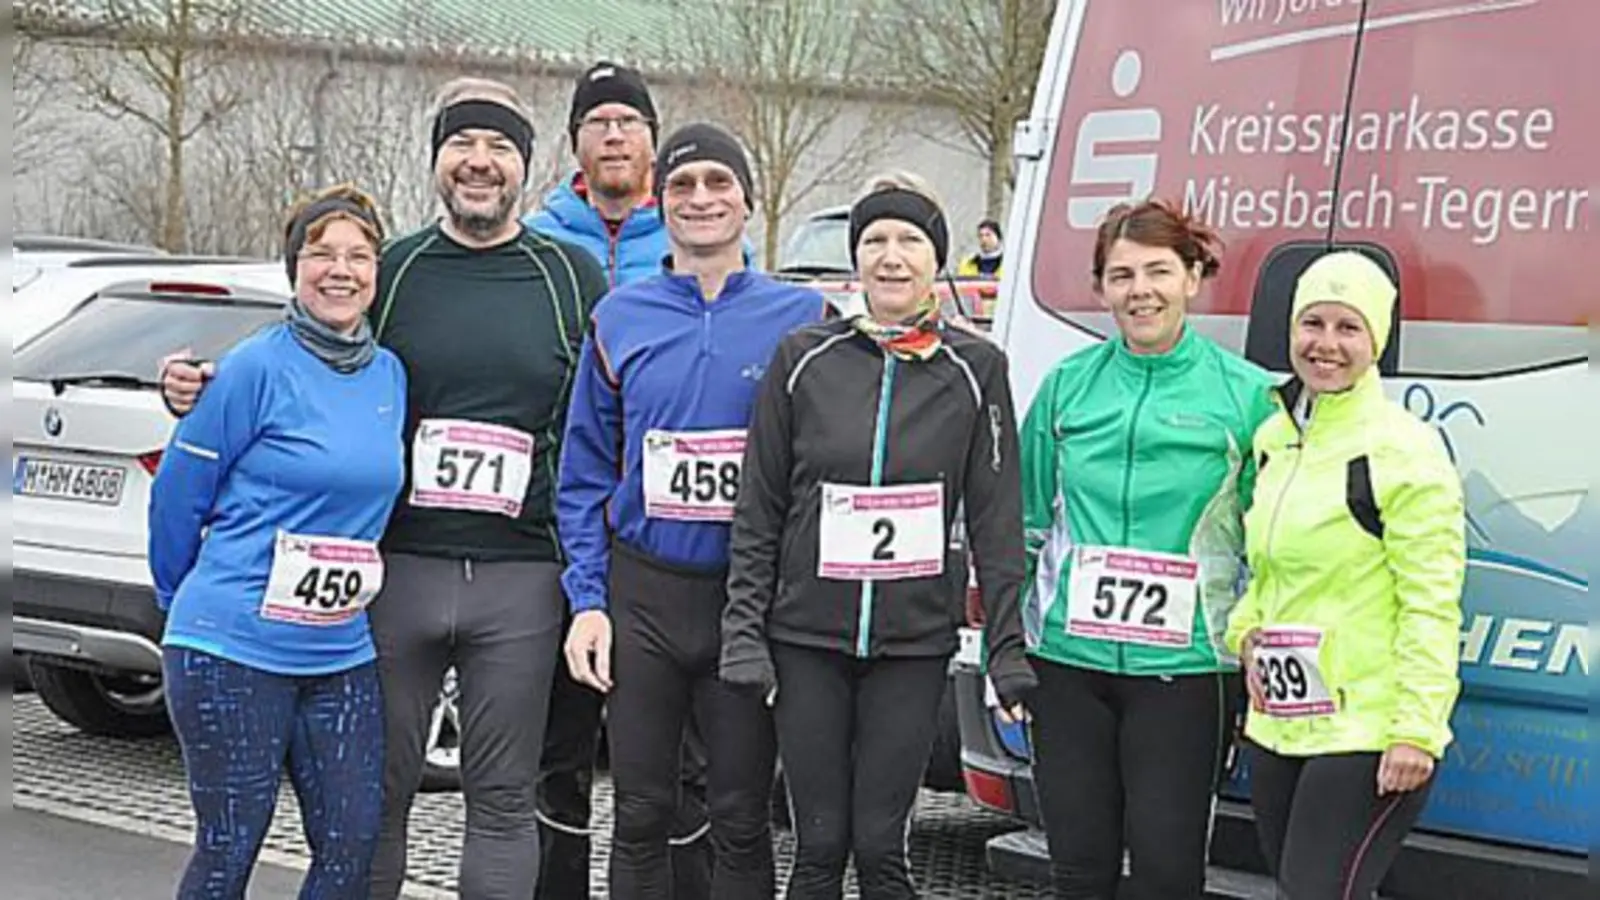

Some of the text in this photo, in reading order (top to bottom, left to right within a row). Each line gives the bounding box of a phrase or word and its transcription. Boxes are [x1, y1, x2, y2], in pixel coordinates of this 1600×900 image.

[1190, 96, 1554, 167] Kreissparkasse
[435, 447, 505, 494] 571
[669, 460, 740, 503] 458
[871, 516, 896, 561] 2
[293, 566, 362, 609] 459
[1092, 576, 1168, 626] 572
